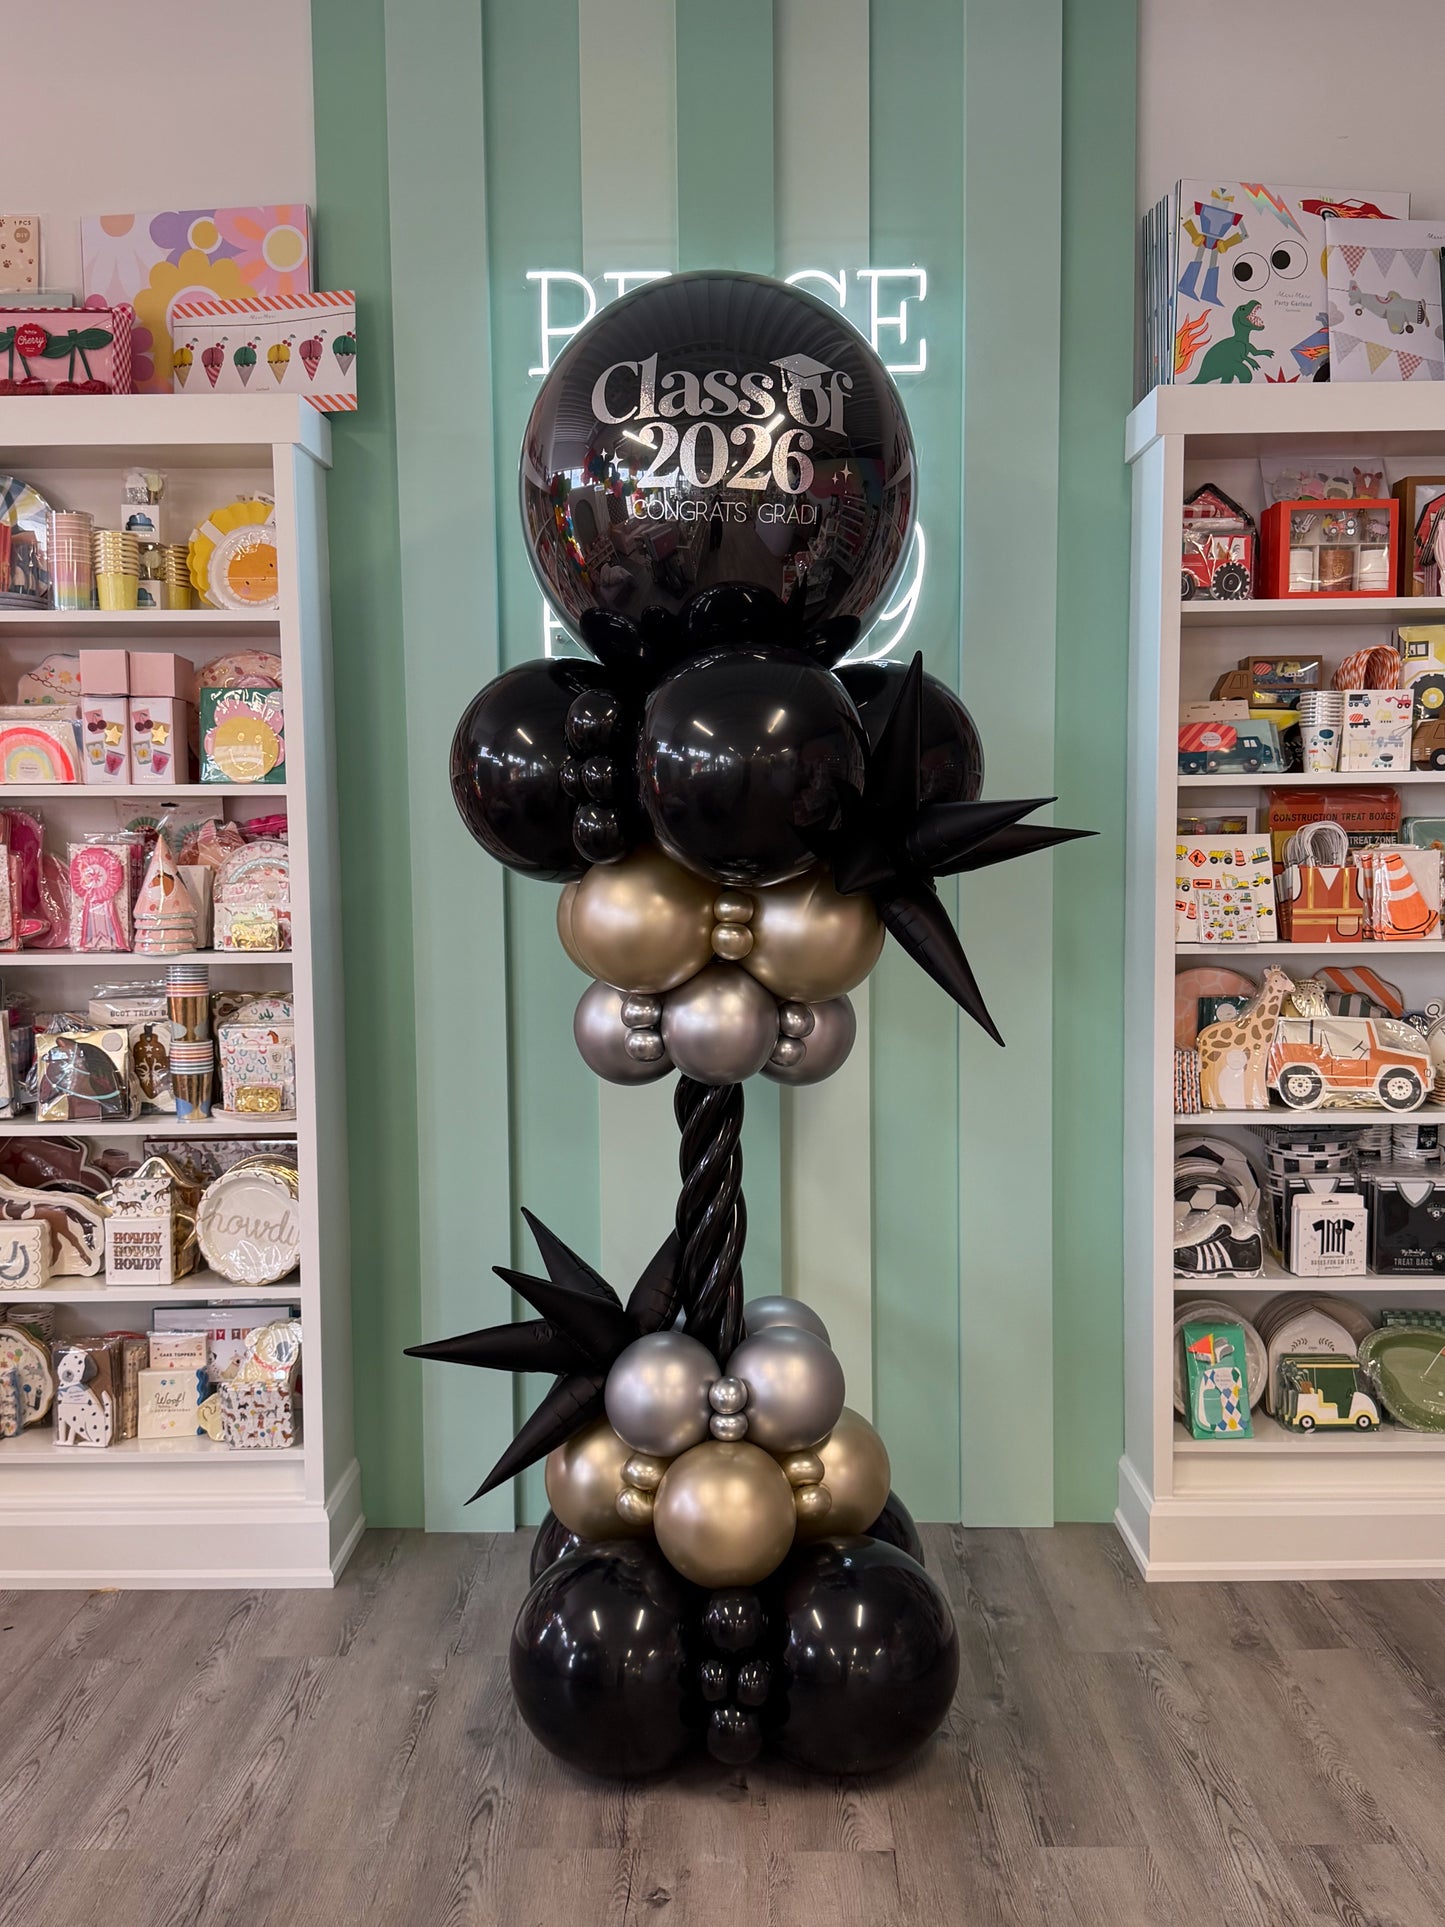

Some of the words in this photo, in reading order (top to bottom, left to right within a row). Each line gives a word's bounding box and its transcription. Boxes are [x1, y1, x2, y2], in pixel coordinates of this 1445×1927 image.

[17, 335, 44, 348] Cherry
[591, 352, 776, 425] Class
[786, 369, 854, 437] of
[636, 421, 815, 495] 2026
[632, 499, 748, 523] CONGRATS
[757, 502, 818, 525] GRAD!
[1273, 813, 1337, 822] CONSTRUCTION
[1341, 812, 1366, 821] TREAT
[1368, 811, 1396, 820] BOXES
[1349, 836, 1373, 845] TREAT
[1374, 836, 1397, 844] ZONE
[113, 1232, 163, 1244] HOWDY
[113, 1245, 163, 1257] HOWDY
[114, 1258, 163, 1270] HOWDY
[1394, 1258, 1414, 1266] TREAT
[1415, 1258, 1434, 1266] BAGS
[154, 1391, 186, 1407] Woof!
